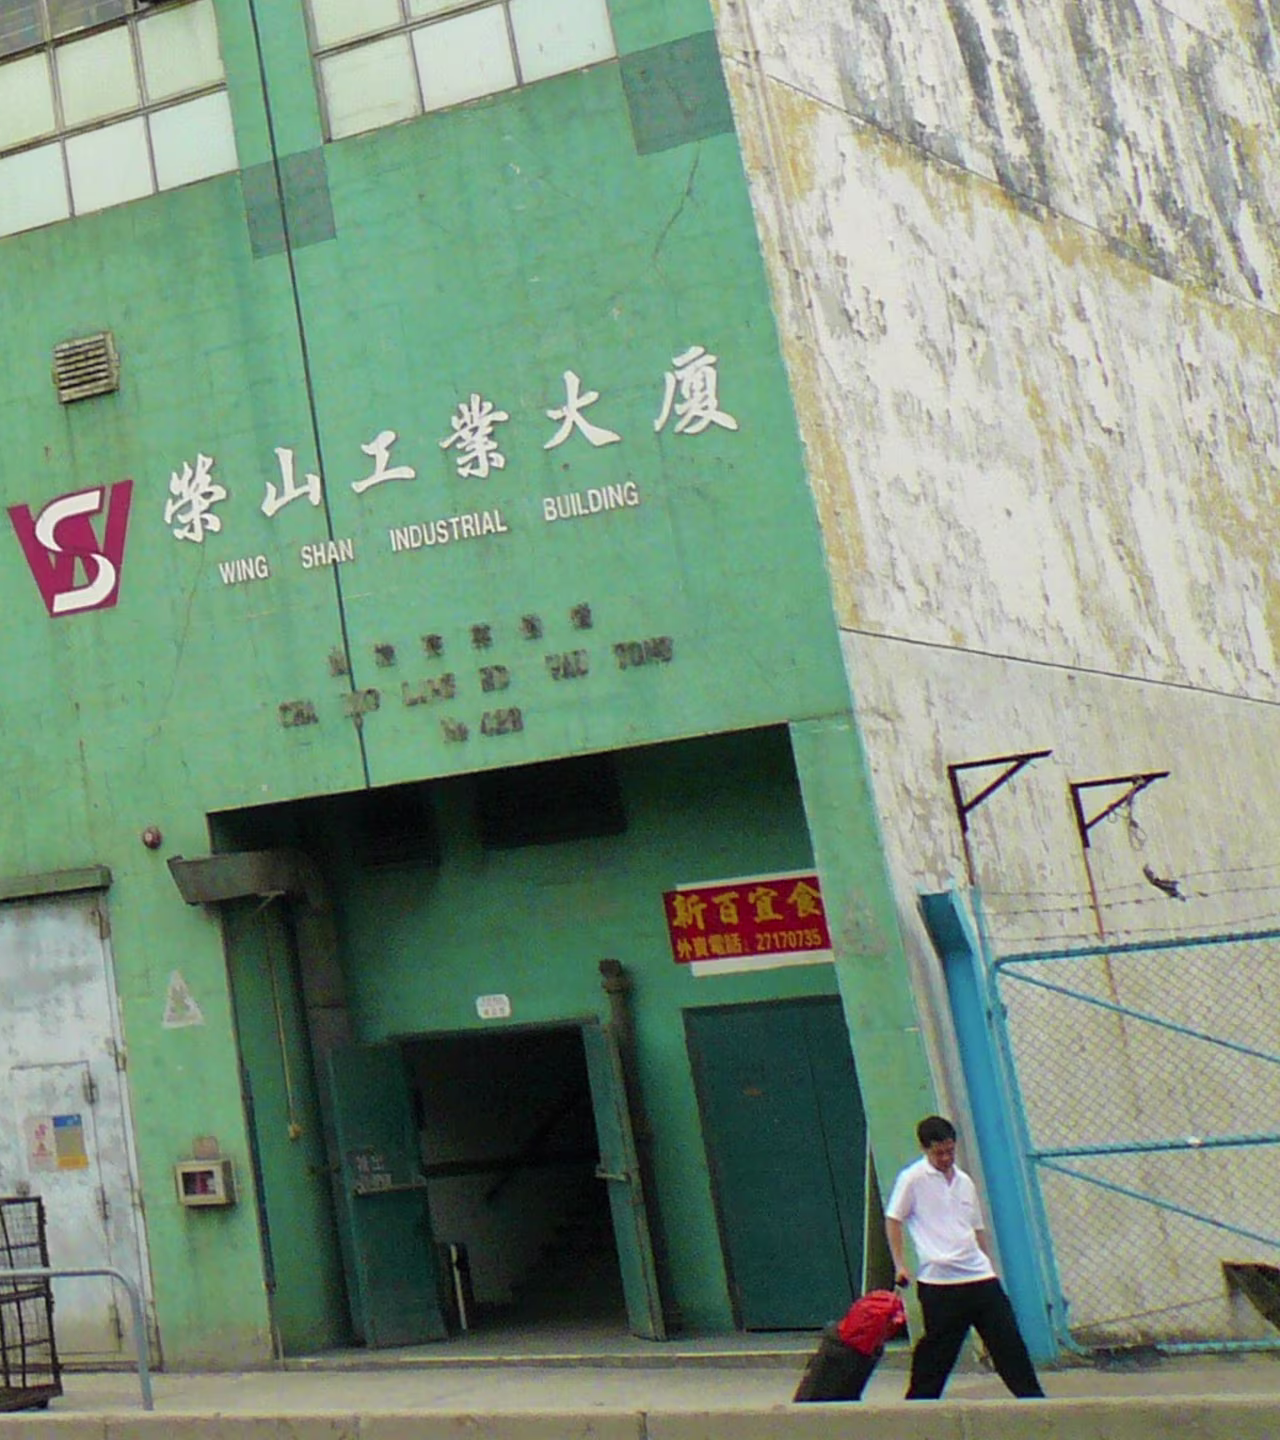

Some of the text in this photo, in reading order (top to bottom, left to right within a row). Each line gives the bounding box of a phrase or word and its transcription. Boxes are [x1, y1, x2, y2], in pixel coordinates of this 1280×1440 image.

[164, 346, 738, 543] 榮山工業大廈
[219, 481, 639, 585] WING SHAN INDUSTRIAL BUILDING
[756, 927, 823, 952] 27170735
